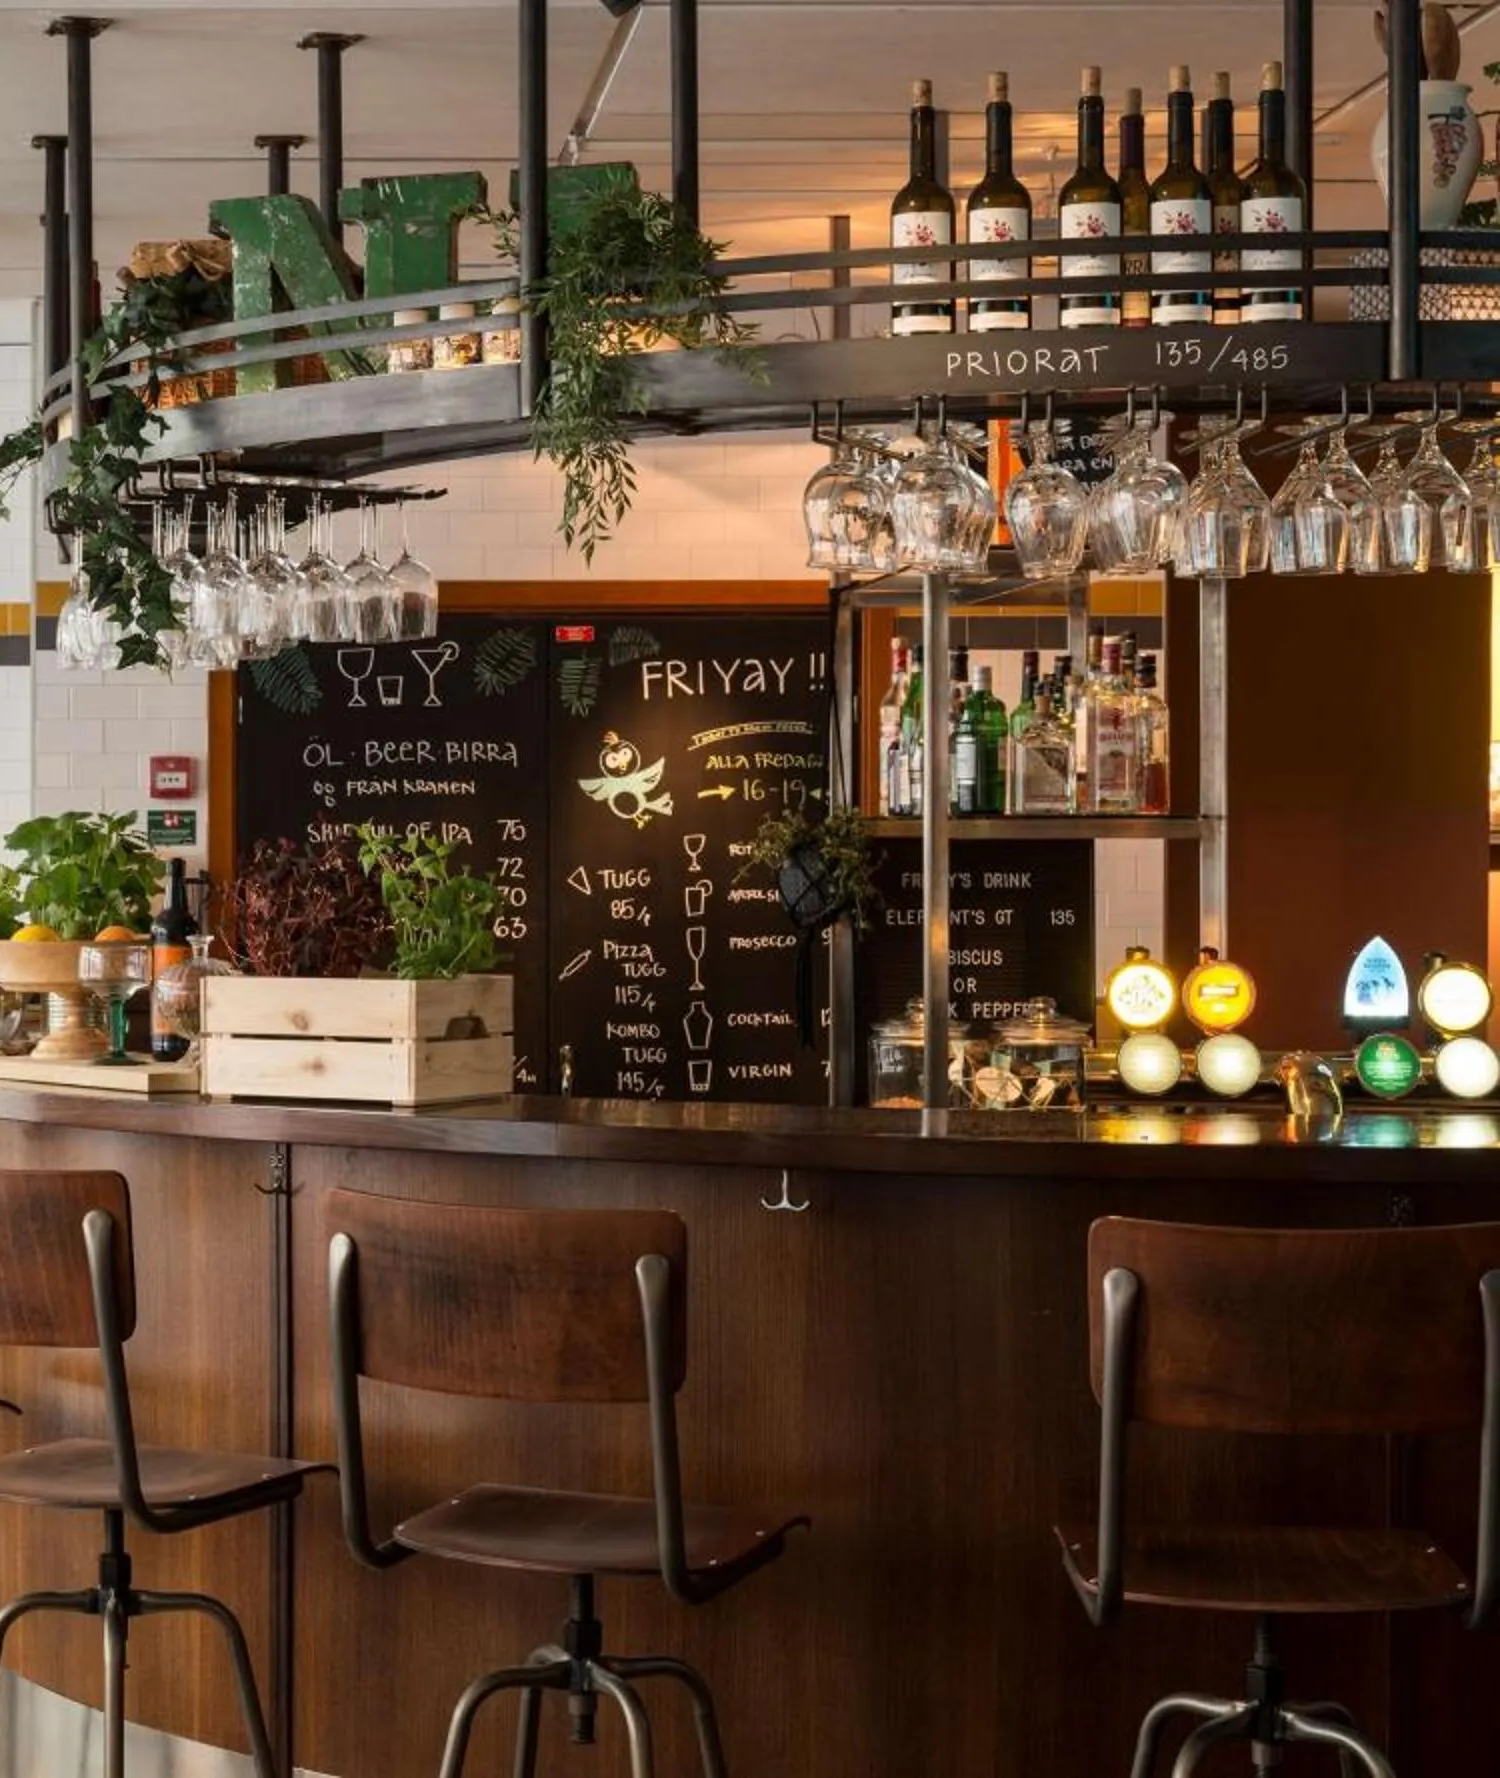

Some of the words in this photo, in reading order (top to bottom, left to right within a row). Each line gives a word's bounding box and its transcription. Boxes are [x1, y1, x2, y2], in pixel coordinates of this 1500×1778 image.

[303, 735, 345, 767] ÖL
[497, 819, 527, 841] 75
[497, 857, 525, 879] 72
[597, 868, 651, 890] TUGG
[984, 872, 1032, 889] DRINK
[995, 909, 1014, 926] GT
[1050, 909, 1076, 926] 135
[493, 916, 528, 939] 63
[622, 962, 667, 978] TUGG
[953, 977, 978, 994] OR
[727, 1062, 793, 1079] VIRGIN
